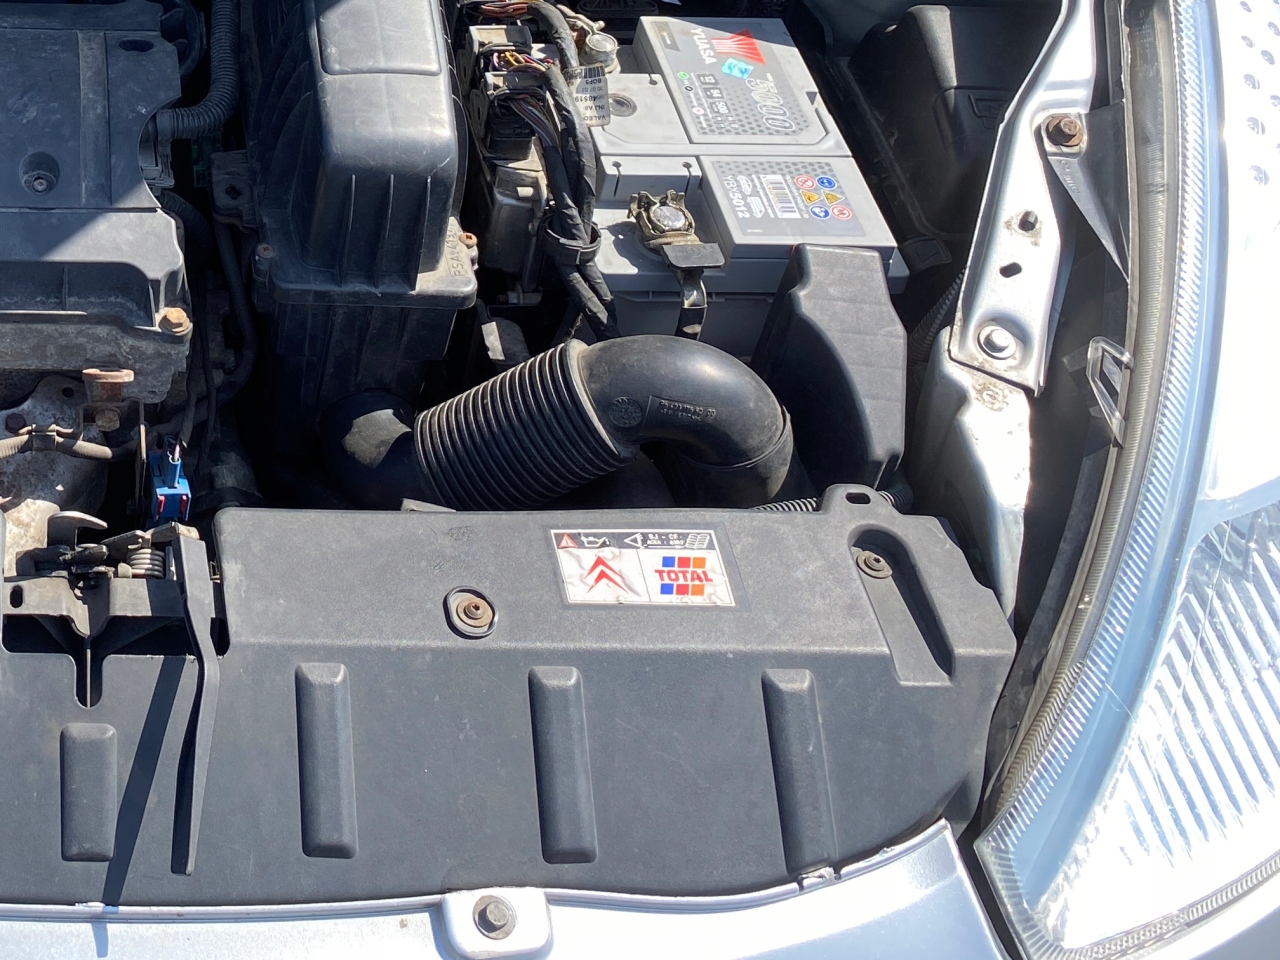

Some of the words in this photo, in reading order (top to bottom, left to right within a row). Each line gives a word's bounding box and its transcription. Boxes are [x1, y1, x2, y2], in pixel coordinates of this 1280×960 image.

[690, 27, 718, 65] YUASA
[745, 76, 796, 131] 5000
[722, 174, 751, 219] YBX5012
[654, 569, 714, 583] TOTAL
